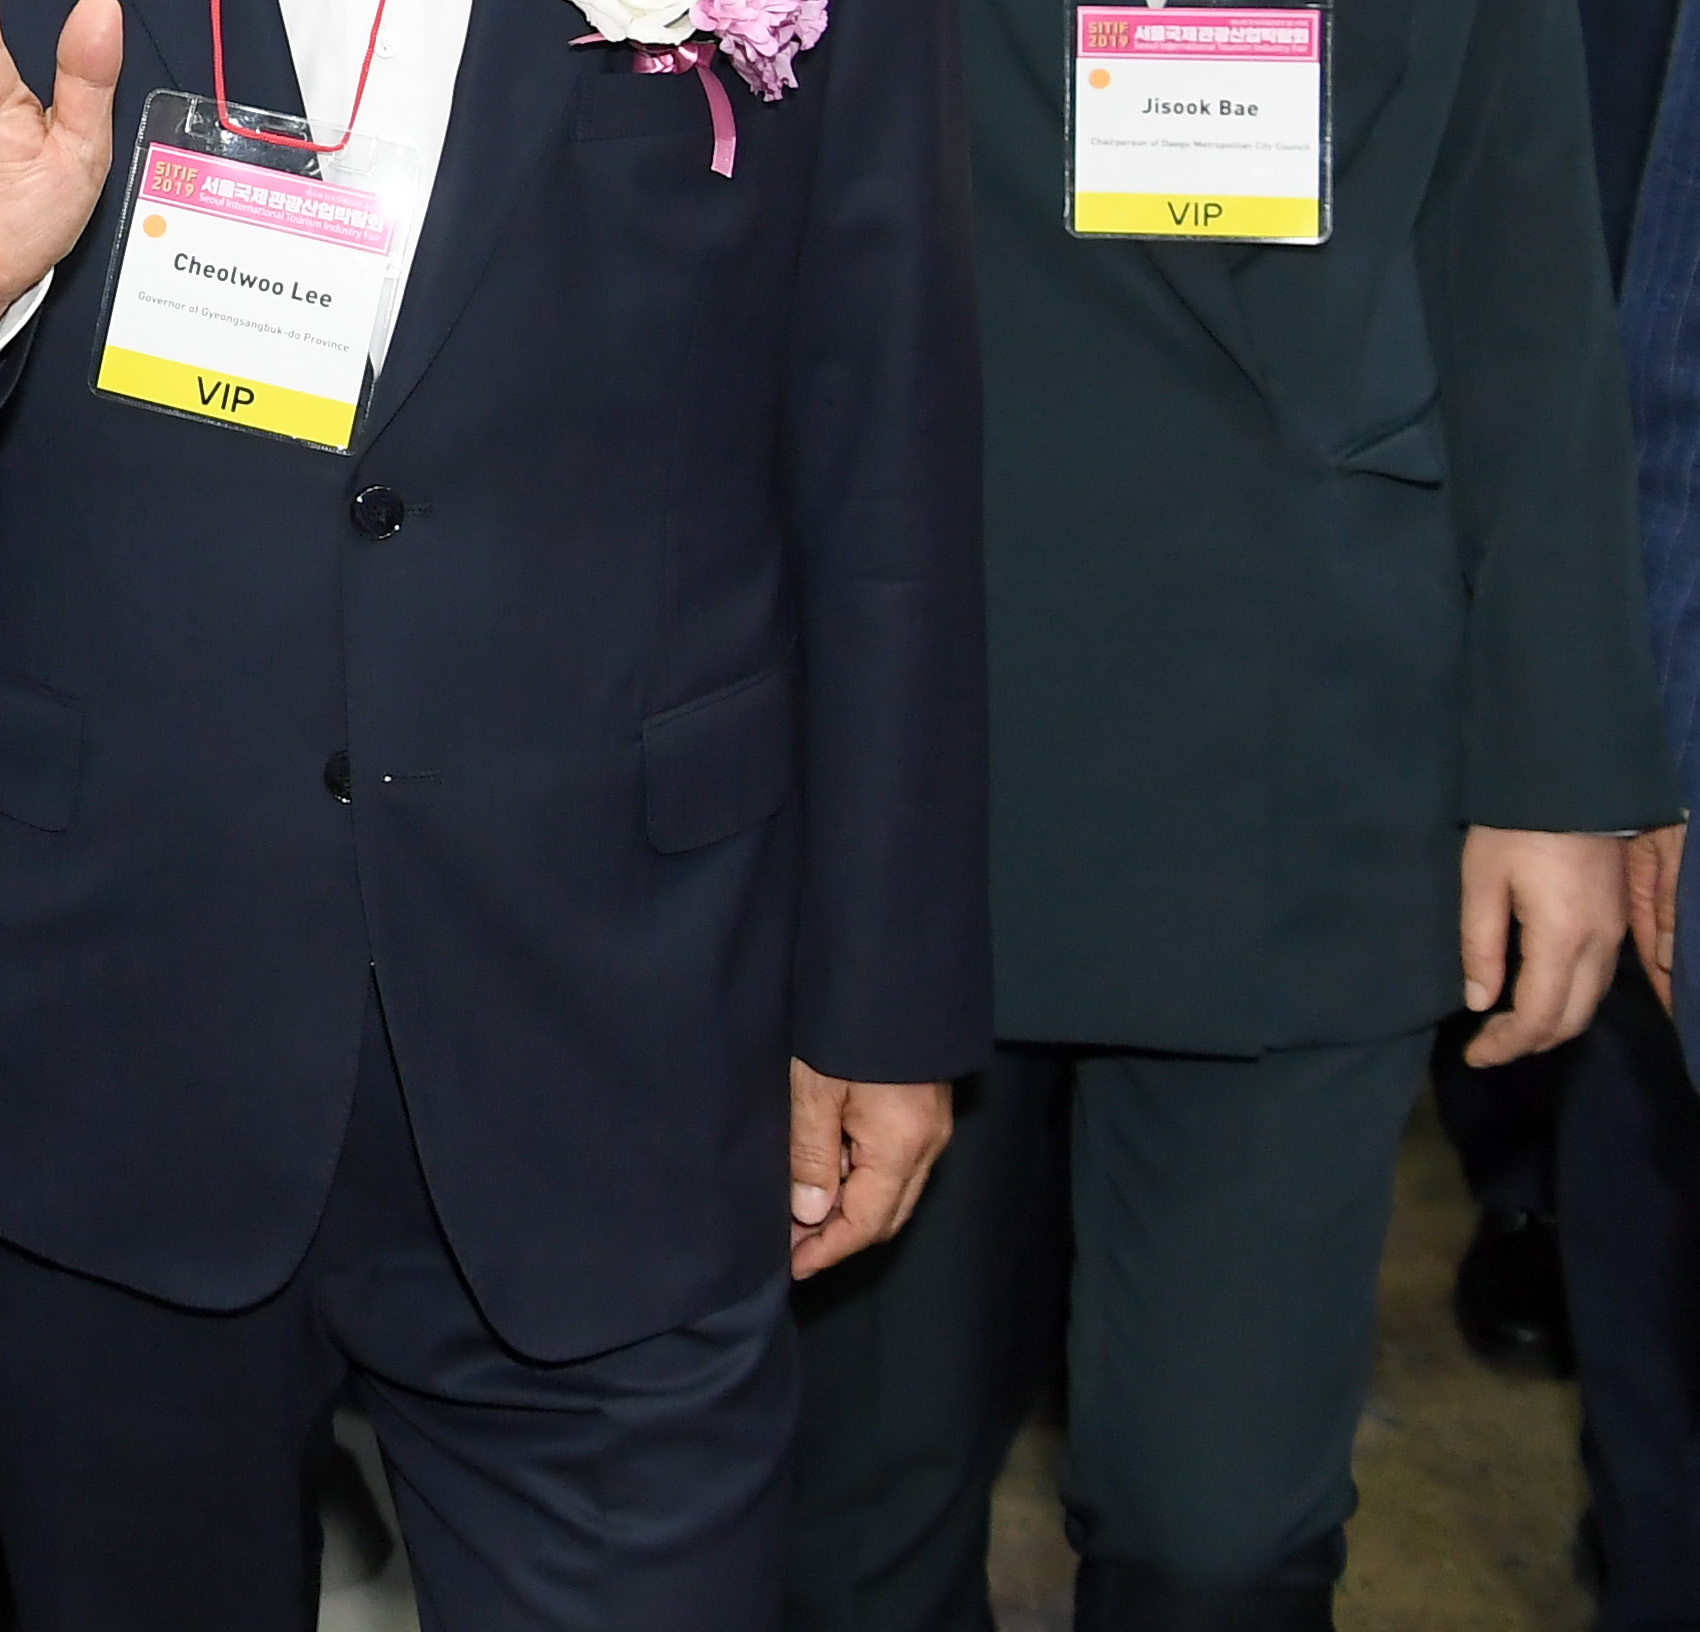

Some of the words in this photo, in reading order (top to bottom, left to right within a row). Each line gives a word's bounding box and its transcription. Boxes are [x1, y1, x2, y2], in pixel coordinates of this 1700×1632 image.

[1089, 22, 1129, 34] SITIF
[1089, 35, 1129, 48] 2019
[1141, 98, 1211, 116] Jisook
[1219, 100, 1259, 116] Bae
[154, 161, 198, 182] SITIF
[151, 176, 195, 198] 2019
[201, 176, 385, 233] 서울국제관광산업박람회
[1167, 202, 1223, 227] VIP
[199, 193, 224, 206] Seoul
[226, 198, 285, 219] International
[286, 212, 322, 228] Tourism
[323, 219, 362, 240] Industry
[363, 230, 381, 242] Fair
[173, 253, 284, 296] Cheolwoo
[291, 282, 333, 307] Lee
[138, 290, 187, 311] Governor
[188, 304, 199, 314] of
[201, 307, 301, 340] Gyeongsangbuk-do
[303, 332, 350, 353] Province
[197, 376, 255, 413] VIP
